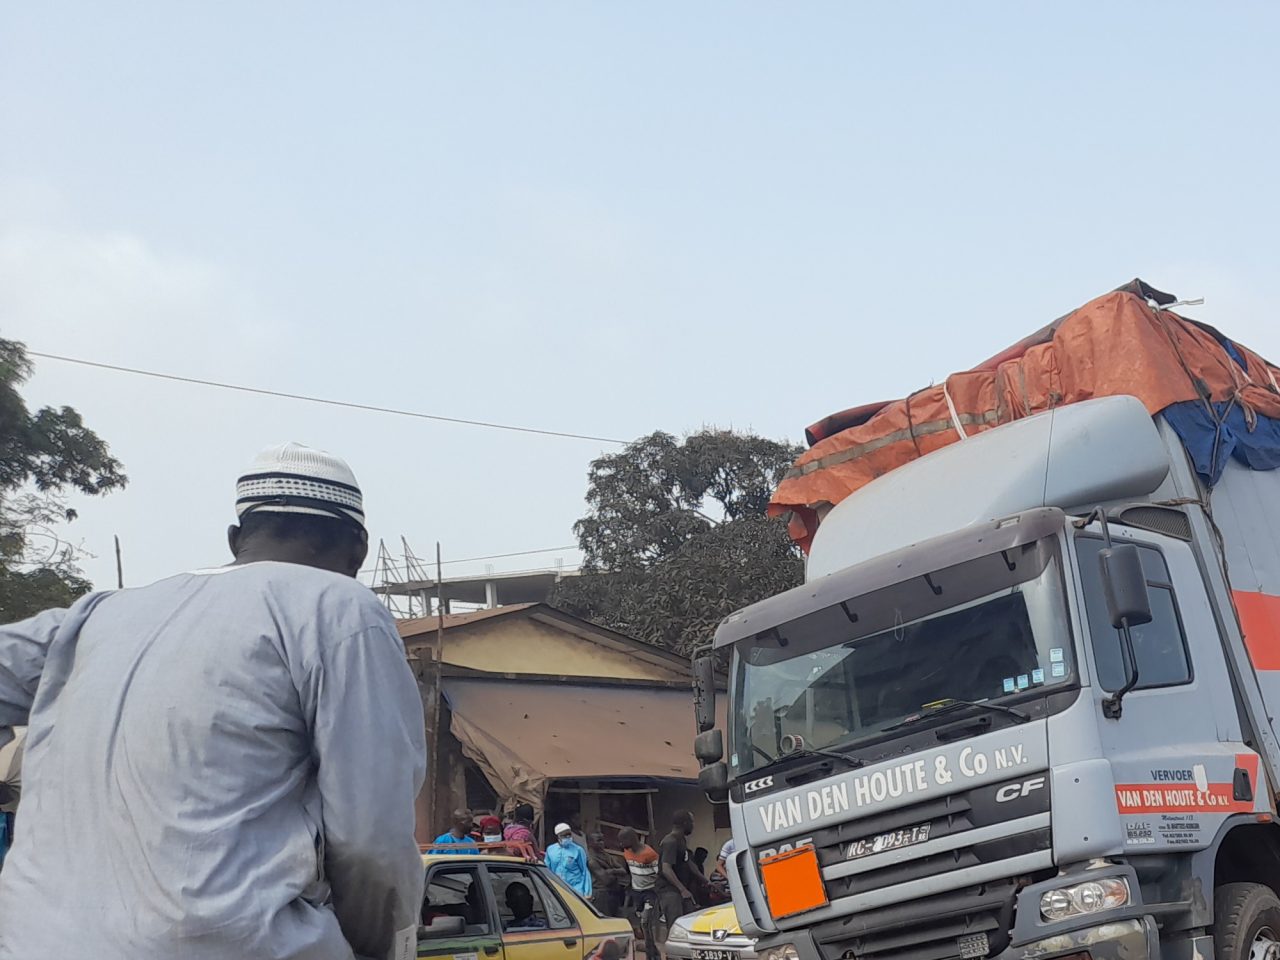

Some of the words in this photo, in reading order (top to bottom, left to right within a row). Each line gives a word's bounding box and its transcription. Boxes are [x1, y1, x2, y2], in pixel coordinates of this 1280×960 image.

[1150, 769, 1194, 781] VERVOER
[759, 795, 801, 833] VAN
[808, 783, 848, 821] DEN
[854, 759, 928, 807] HOUTE
[934, 755, 953, 784] &
[959, 746, 988, 778] Co
[995, 743, 1028, 770] N.V.
[995, 777, 1046, 802] CF
[1117, 790, 1141, 807] VAN
[1143, 790, 1163, 806] DEN
[1165, 789, 1194, 806] HOUTE
[1197, 790, 1204, 806] &
